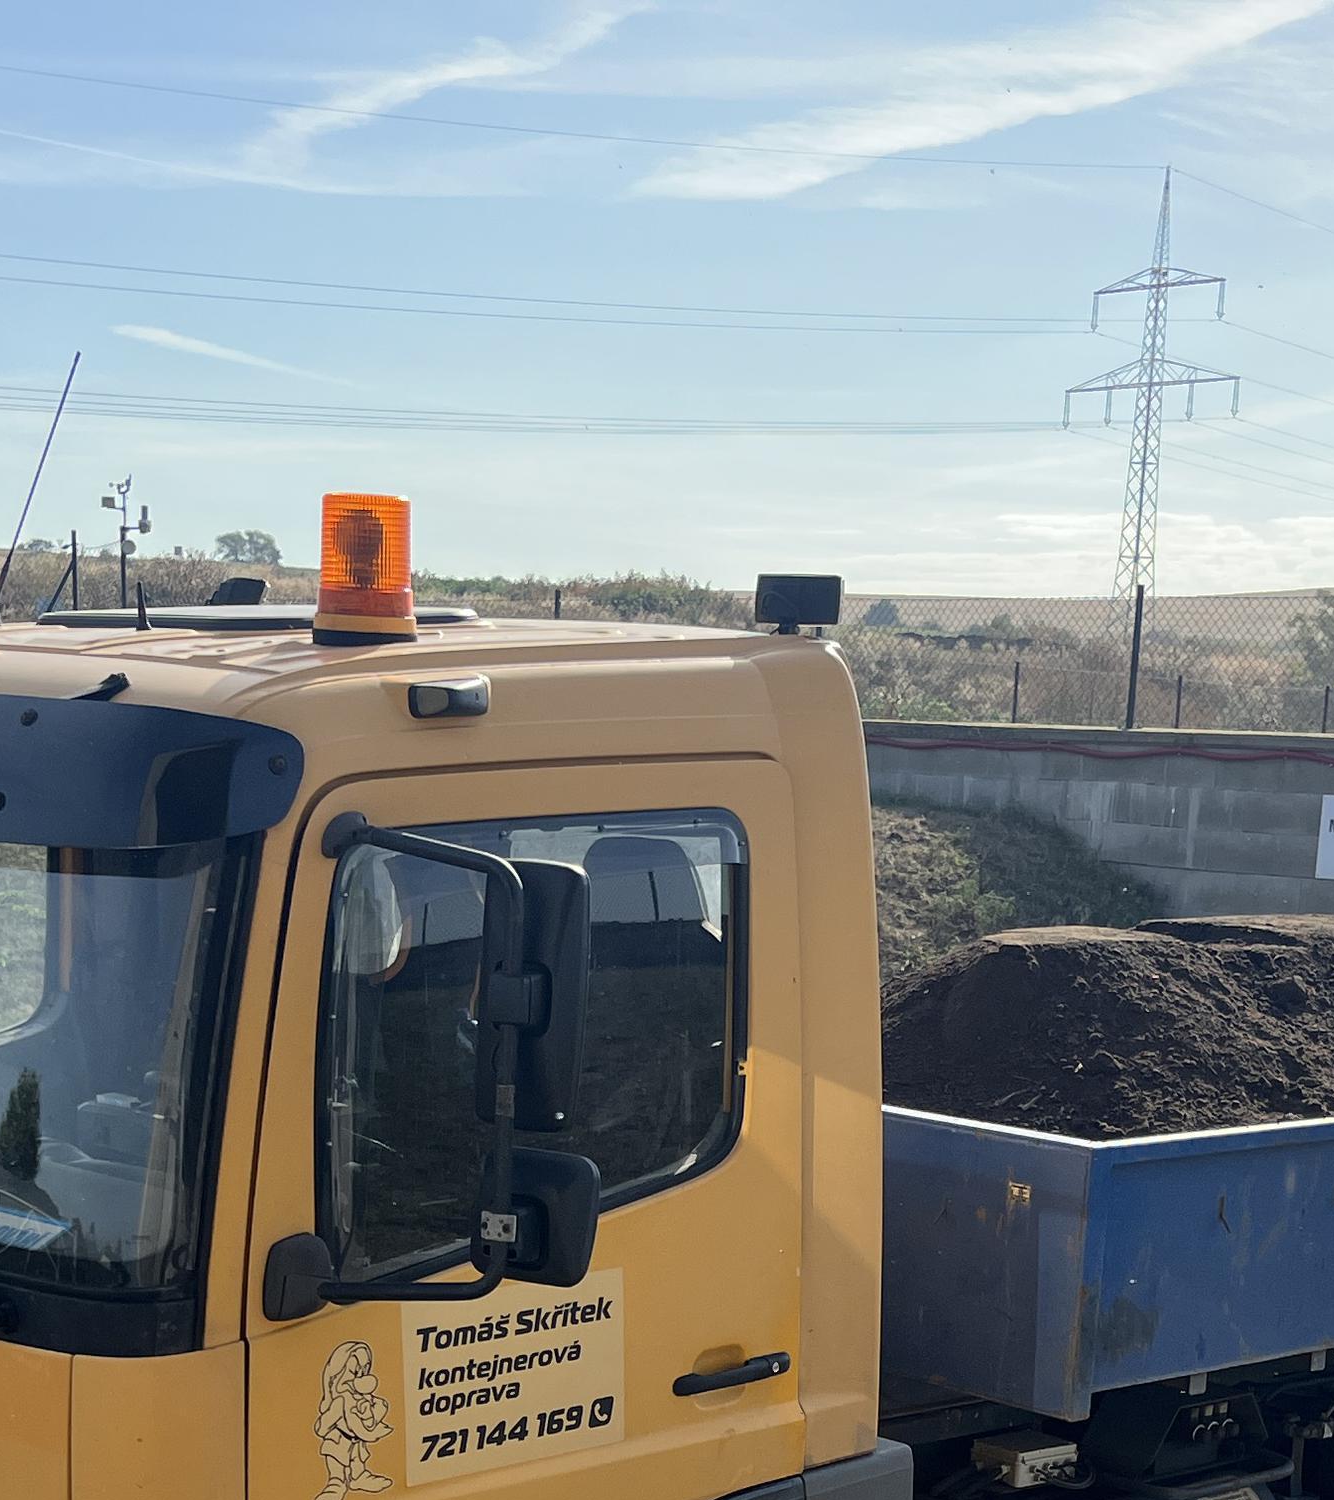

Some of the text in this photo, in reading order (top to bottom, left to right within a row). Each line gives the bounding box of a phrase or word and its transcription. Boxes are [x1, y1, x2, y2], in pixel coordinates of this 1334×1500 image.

[416, 1297, 613, 1353] Tomáš Skřítek
[418, 1340, 582, 1390] kontejnerová
[419, 1382, 521, 1416] doprava
[420, 1405, 584, 1462] 721 144 169
